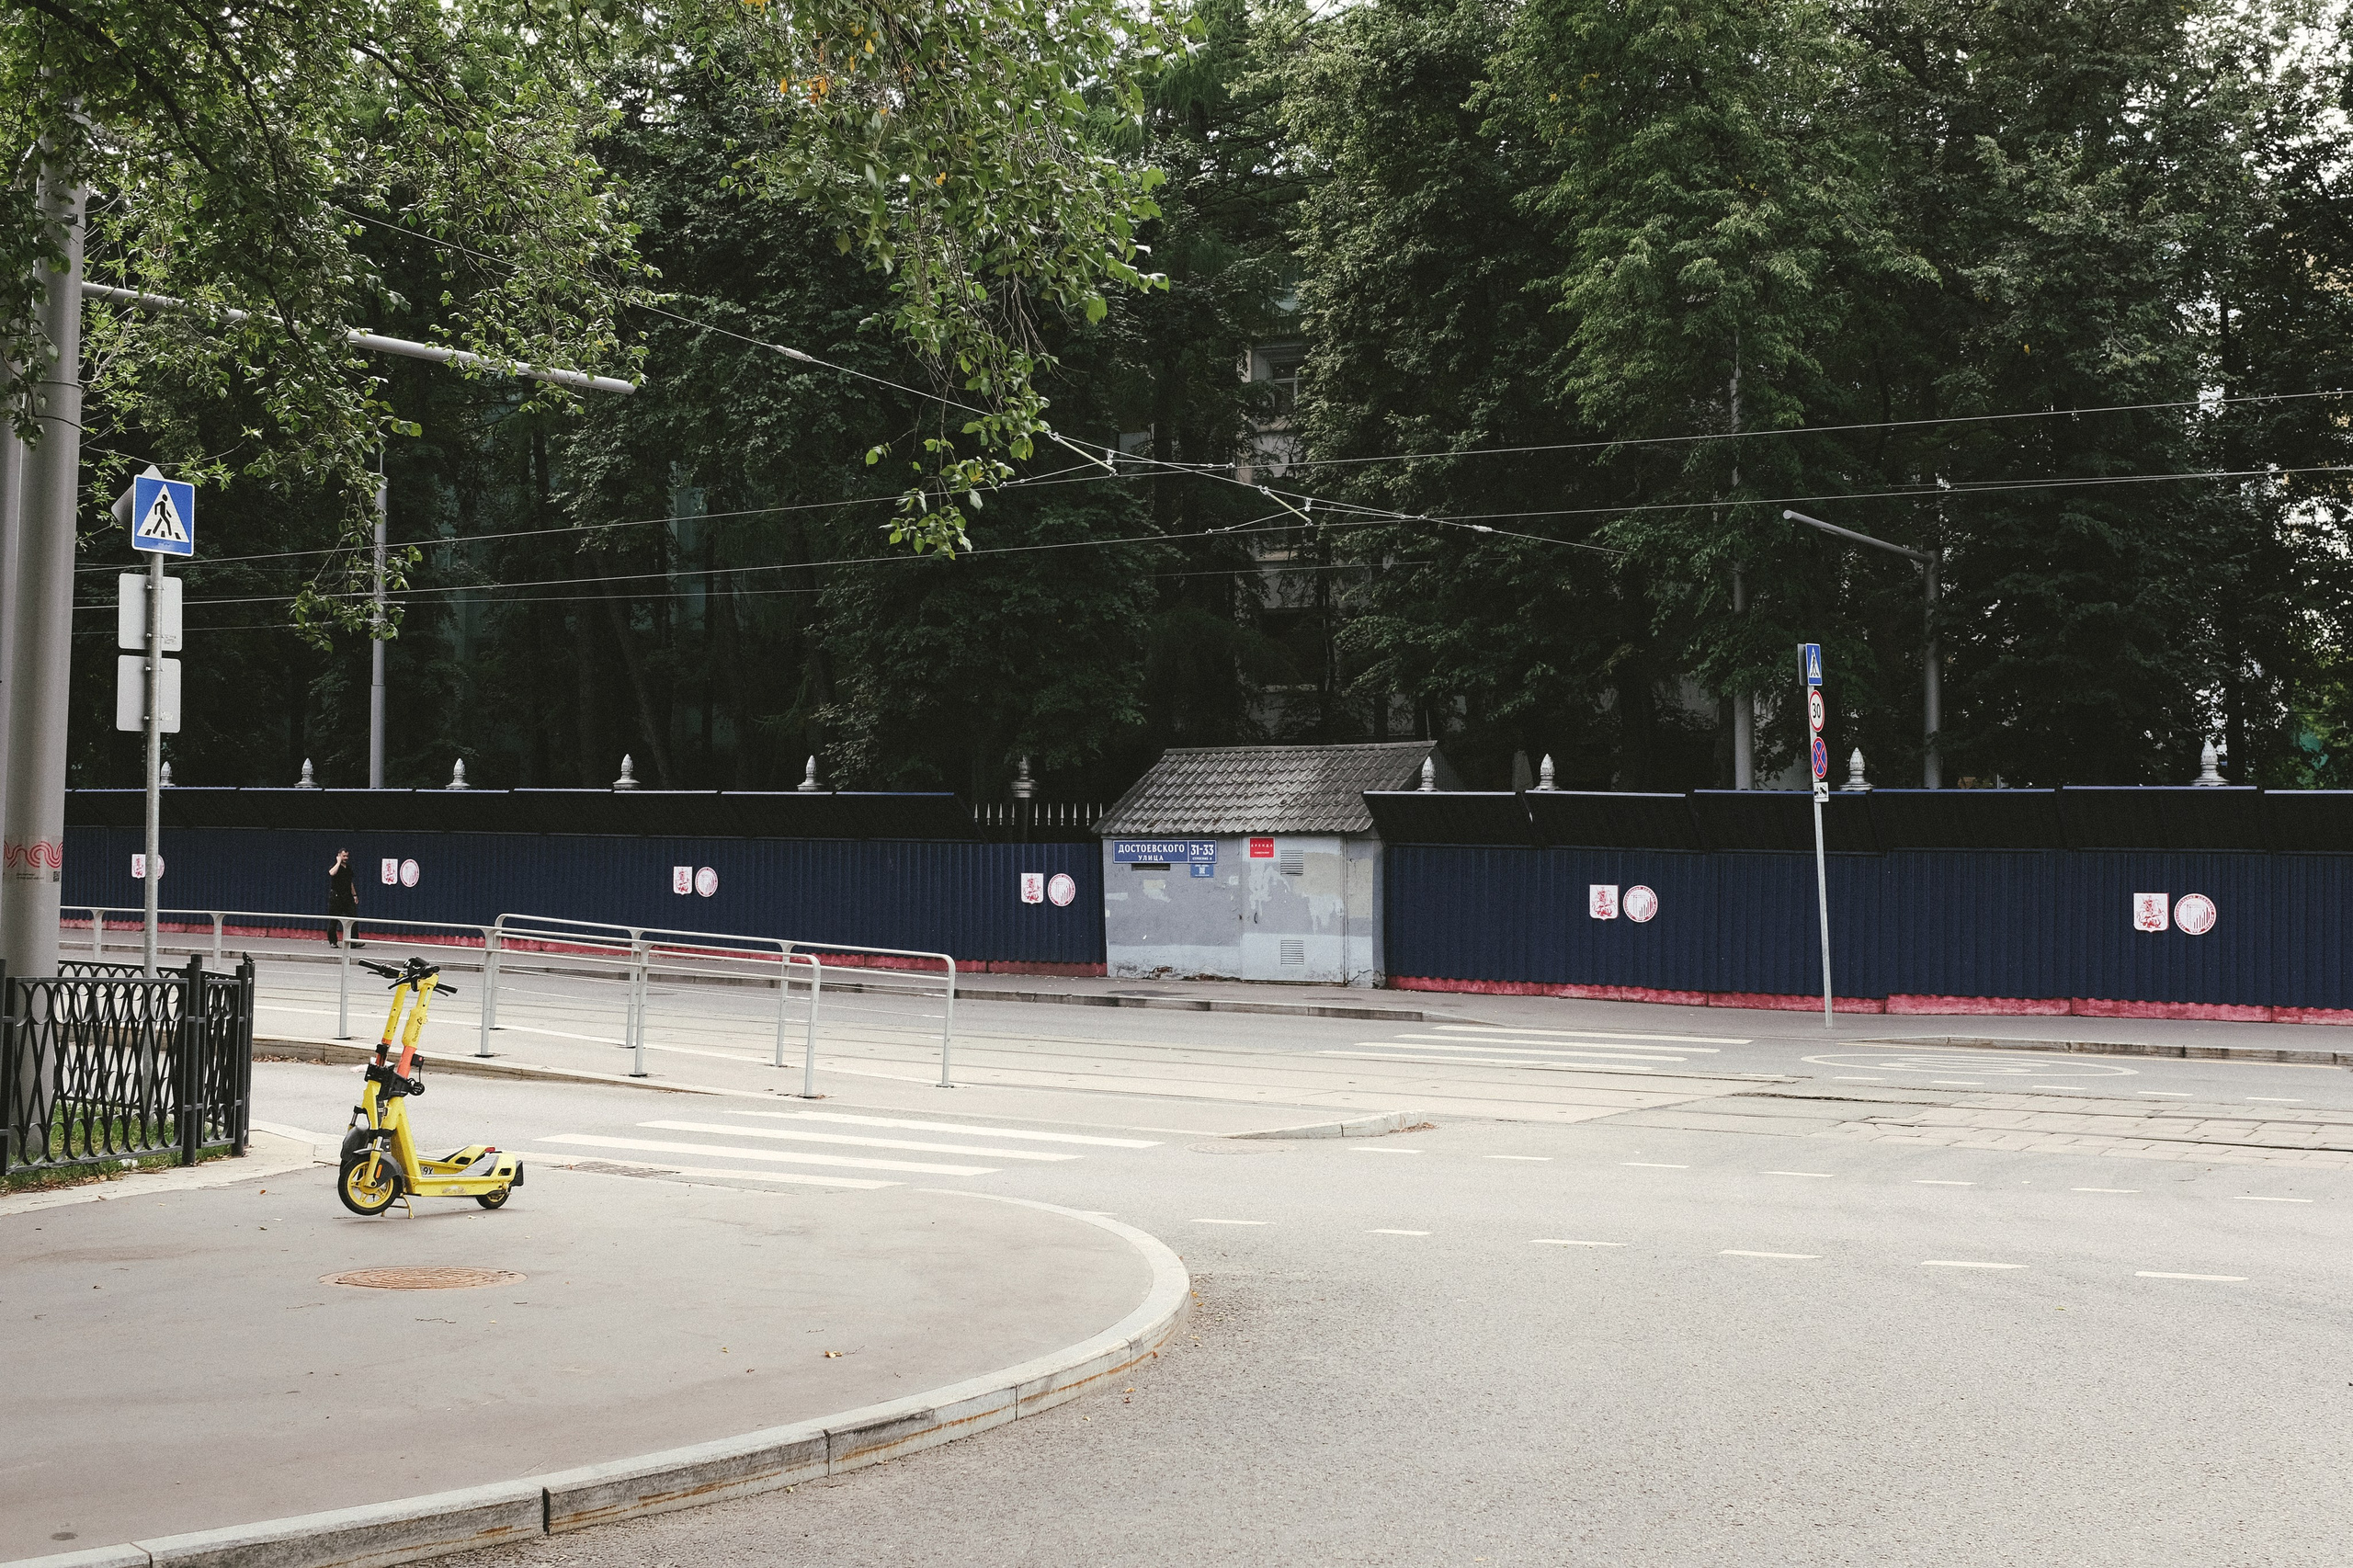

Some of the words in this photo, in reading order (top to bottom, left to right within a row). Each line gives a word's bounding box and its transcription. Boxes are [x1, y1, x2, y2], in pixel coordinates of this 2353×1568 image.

[1813, 702, 1821, 718] 30
[1119, 844, 1185, 854] ДОСТОЕВСКОГО
[1190, 844, 1214, 856] 31-33
